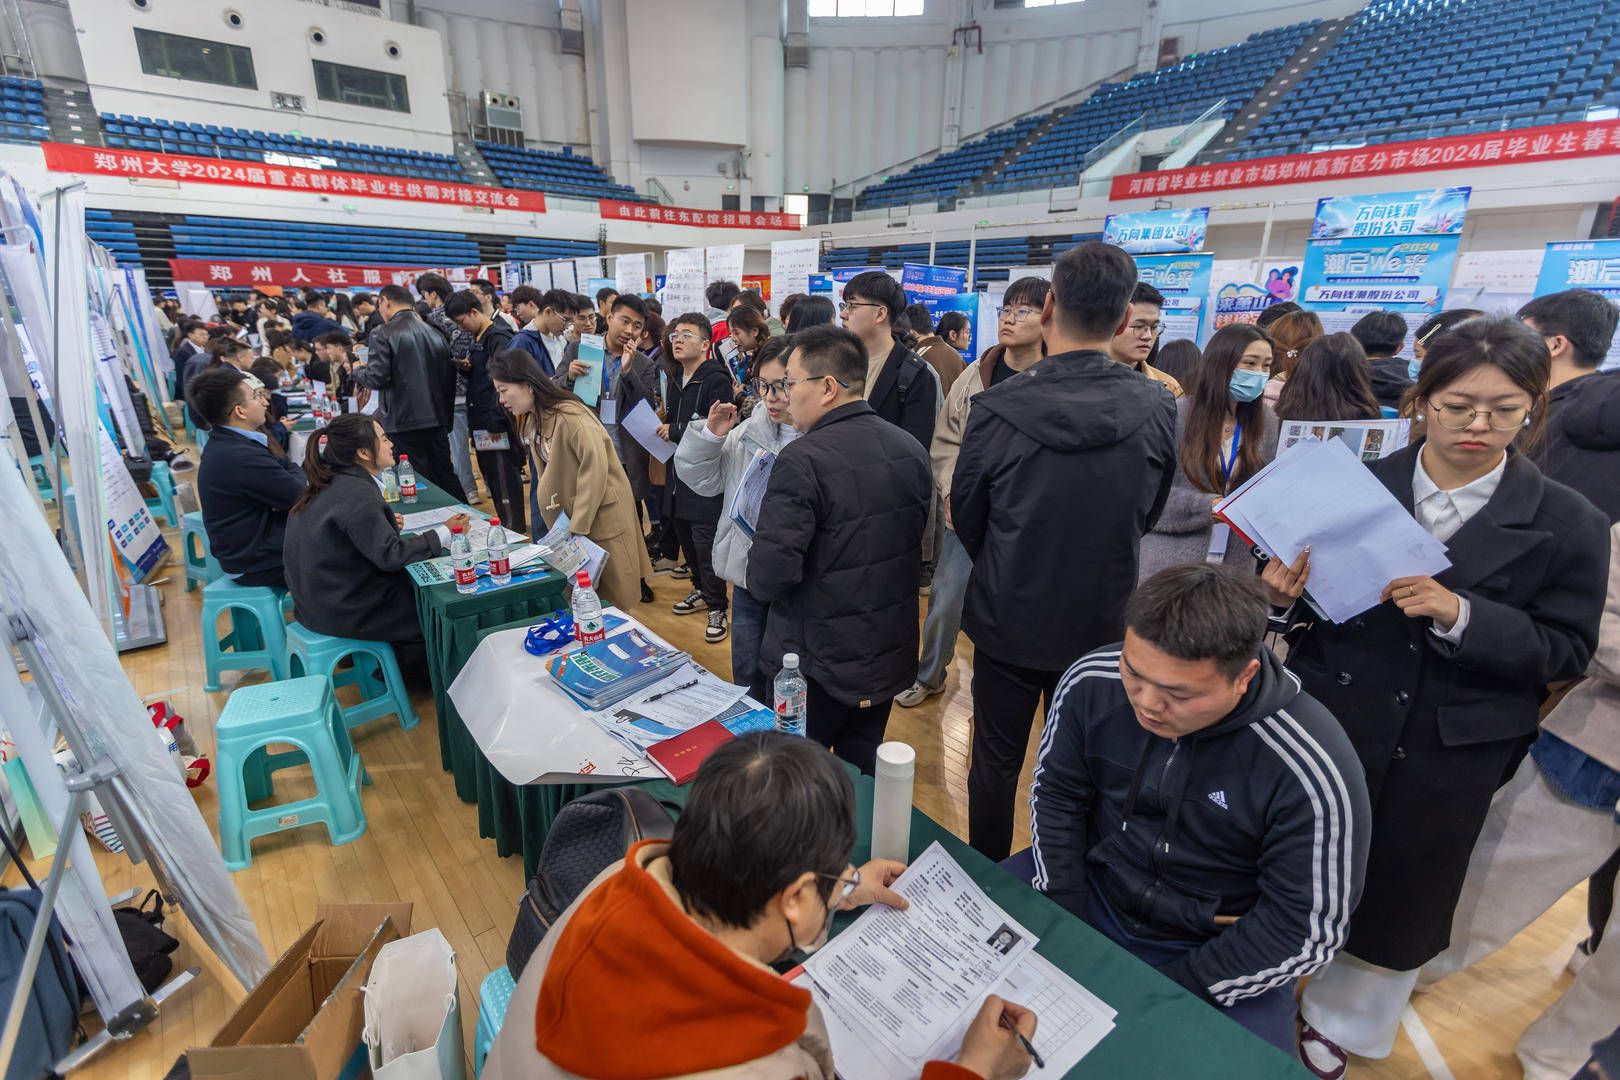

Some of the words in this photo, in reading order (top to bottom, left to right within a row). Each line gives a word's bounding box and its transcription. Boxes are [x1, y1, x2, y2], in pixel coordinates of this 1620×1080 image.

[94, 152, 520, 208] 郑州大学2024届重点群体毕业生供需对接交流会
[618, 204, 782, 227] 由此前往东配馆招聘会场
[1355, 202, 1421, 221] 万向钱潮
[1117, 224, 1190, 242] 万向集团公司
[1352, 219, 1415, 236] 股份公司
[1399, 242, 1440, 253] 2024
[1319, 290, 1420, 300] 万向钱潮股份公司
